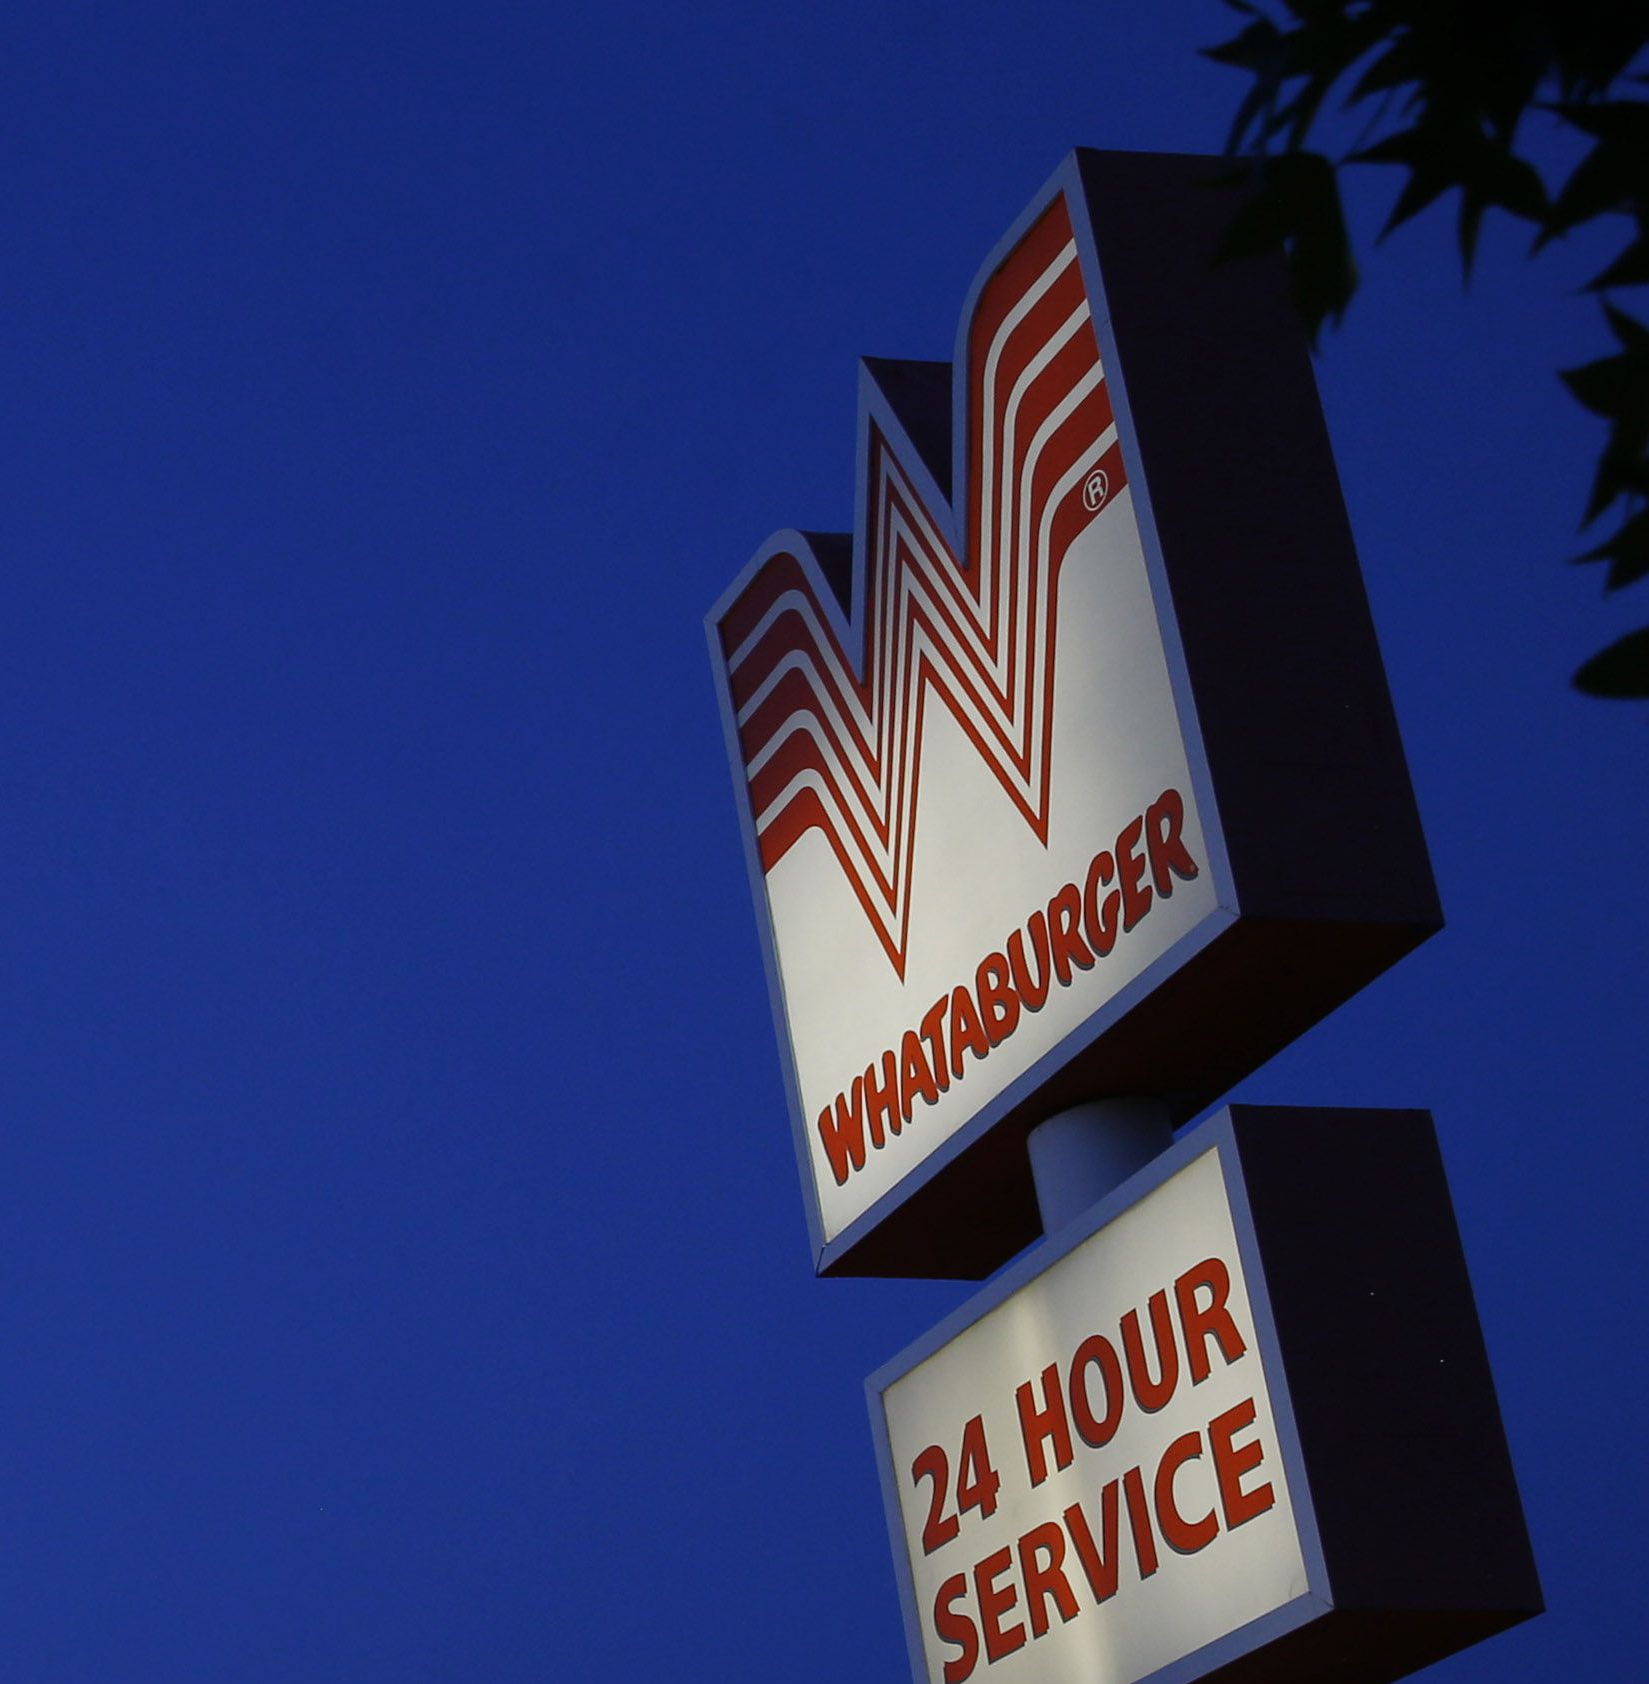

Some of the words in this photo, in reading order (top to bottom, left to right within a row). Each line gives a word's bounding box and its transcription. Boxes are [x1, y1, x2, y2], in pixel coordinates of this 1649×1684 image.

[818, 788, 1199, 1187] WHATABURGER
[911, 1414, 1001, 1557] 24
[1015, 1257, 1247, 1489] HOUR
